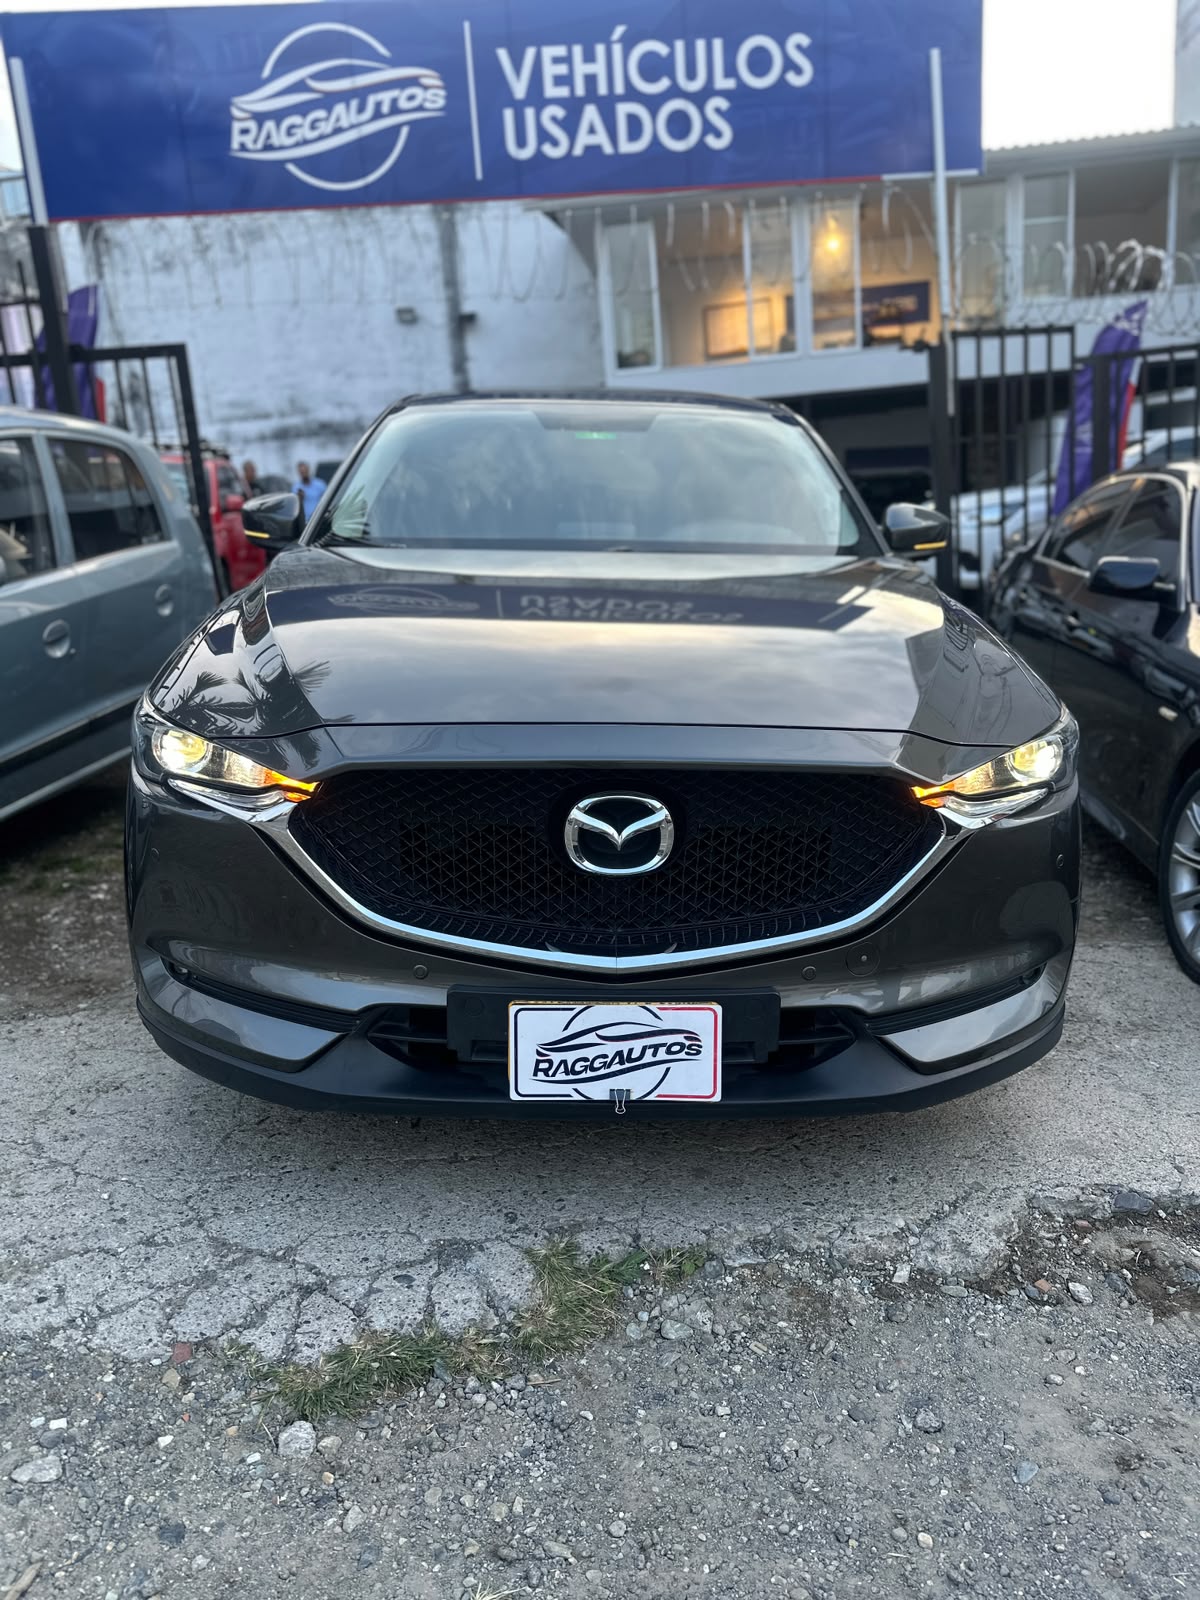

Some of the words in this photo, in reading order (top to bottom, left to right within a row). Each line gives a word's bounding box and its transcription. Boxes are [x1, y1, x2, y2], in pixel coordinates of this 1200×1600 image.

[496, 25, 814, 100] VEHÍCULOS
[231, 86, 447, 151] RAGGAUTOS
[502, 96, 734, 161] USADOS
[532, 1041, 703, 1078] RAGGAUTOS
